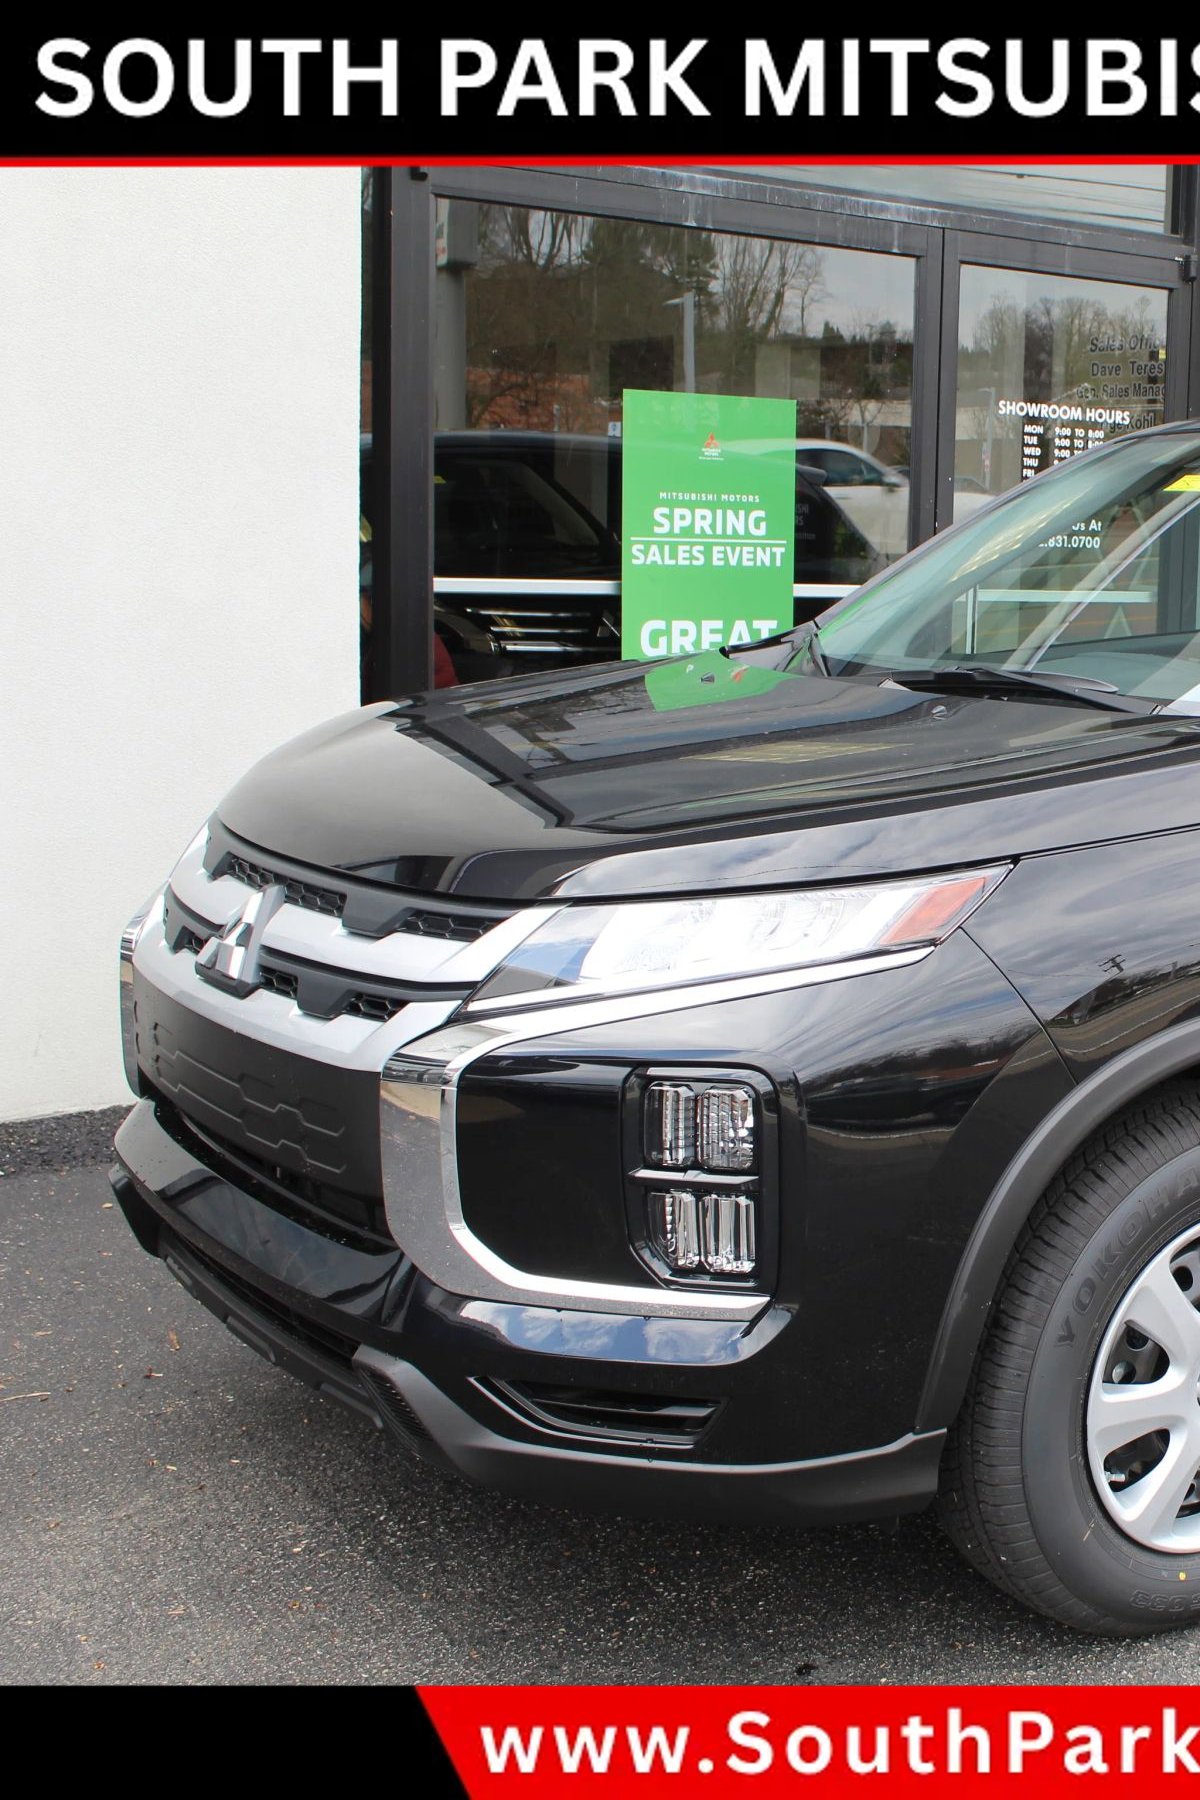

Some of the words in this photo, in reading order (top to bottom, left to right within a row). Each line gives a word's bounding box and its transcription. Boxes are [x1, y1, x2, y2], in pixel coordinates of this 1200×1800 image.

[1090, 337, 1123, 352] Sales
[1091, 362, 1121, 377] Dave
[1102, 384, 1130, 398] Sales
[998, 400, 1082, 421] SHOWROOM
[1085, 408, 1130, 425] HOURS
[1023, 424, 1044, 434] MON
[1054, 426, 1072, 436] 9:00
[1074, 428, 1085, 438] TO
[1088, 429, 1104, 439] 8:00
[1023, 435, 1038, 445] TUE
[1054, 437, 1071, 447] 9:00
[1073, 439, 1084, 448] TO
[1023, 446, 1041, 456] WED
[1054, 448, 1070, 458] 9:00
[1022, 457, 1039, 467] THU
[659, 492, 717, 501] MITSUBISHI
[721, 494, 760, 503] MOTORS
[653, 507, 767, 537] SPRING
[1088, 519, 1102, 531] At
[631, 544, 705, 566] SALES
[712, 546, 786, 567] EVENT
[640, 619, 778, 657] GREAT
